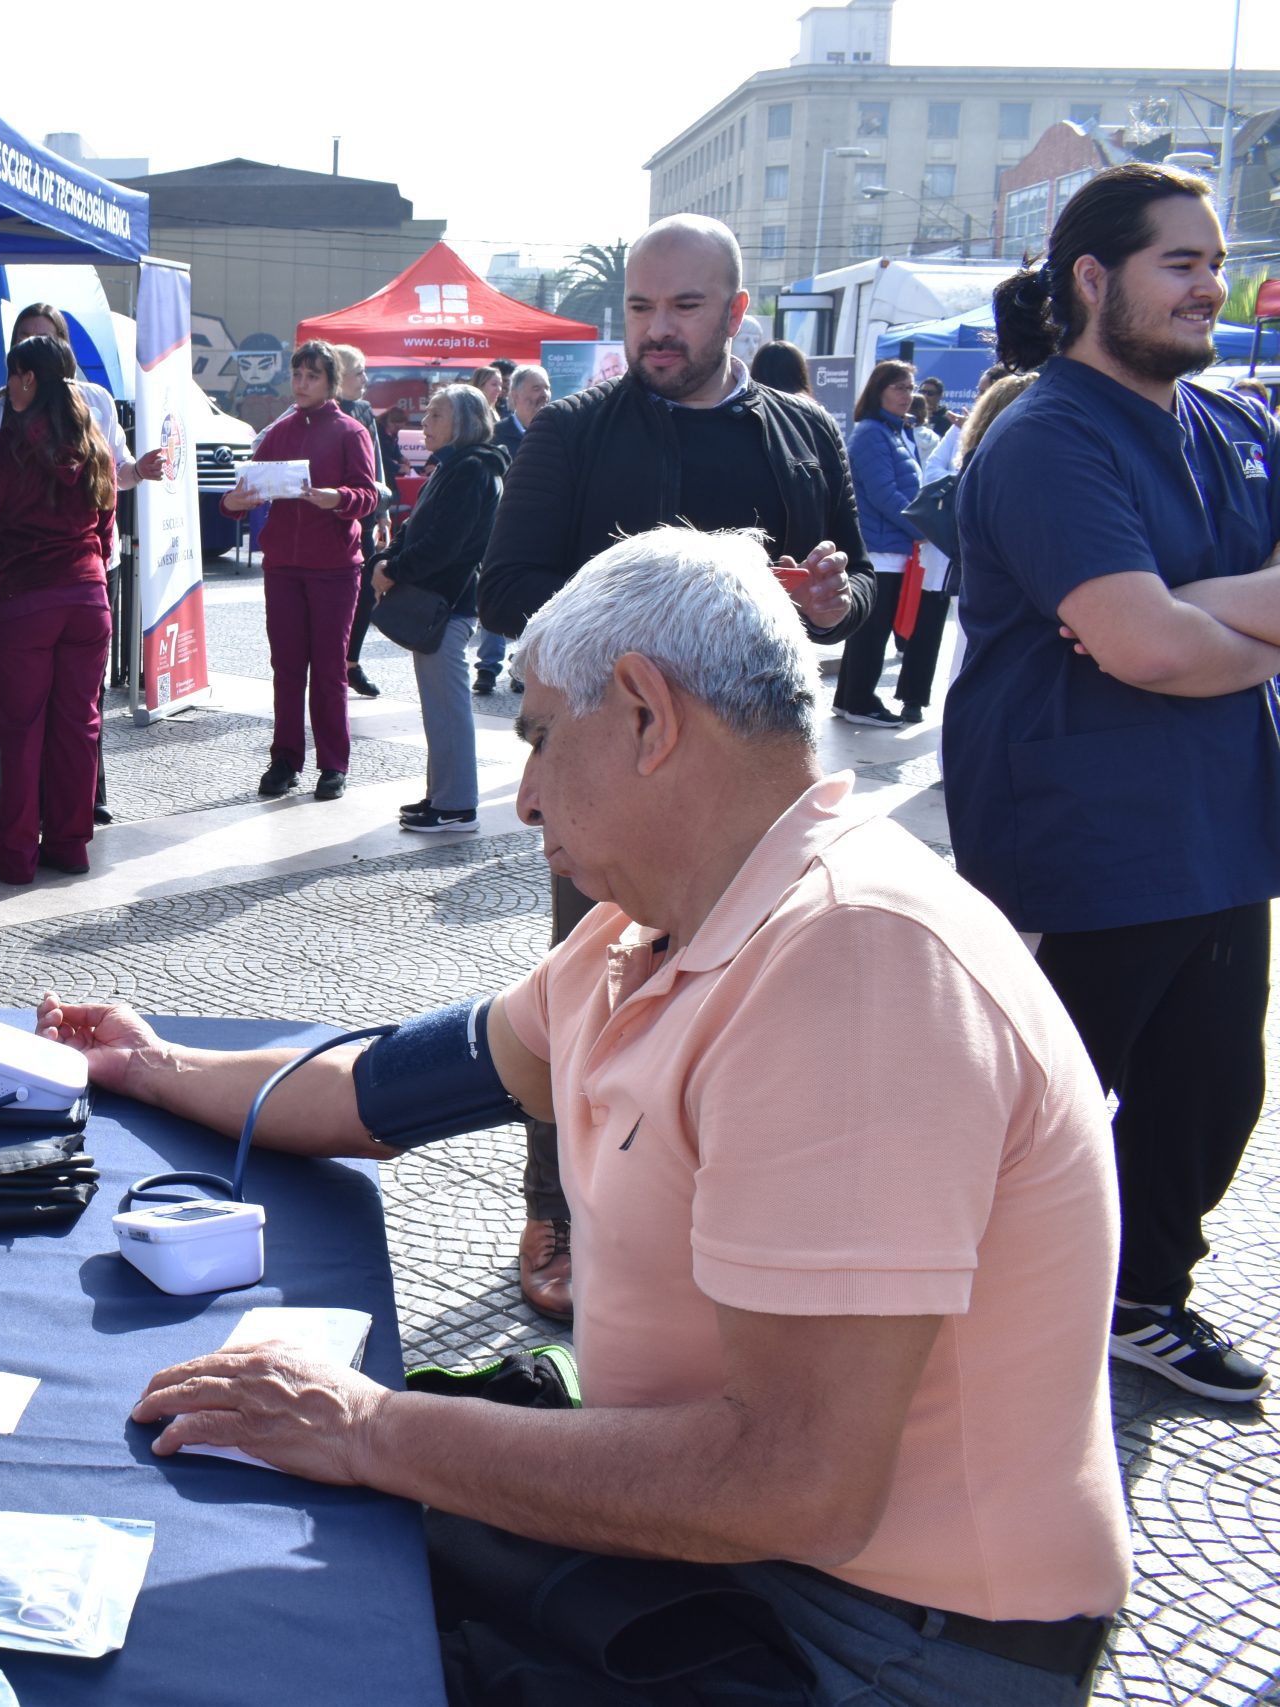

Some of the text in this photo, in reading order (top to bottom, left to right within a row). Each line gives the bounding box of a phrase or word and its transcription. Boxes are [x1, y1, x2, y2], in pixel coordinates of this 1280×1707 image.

[42, 167, 55, 206] DE
[56, 174, 106, 229] TECNOLOGÍA
[106, 197, 132, 241] MÉDICA
[408, 314, 484, 325] Caja 18
[404, 336, 490, 349] www.caja18.cl
[548, 354, 564, 362] Caja
[166, 623, 179, 667] 7
